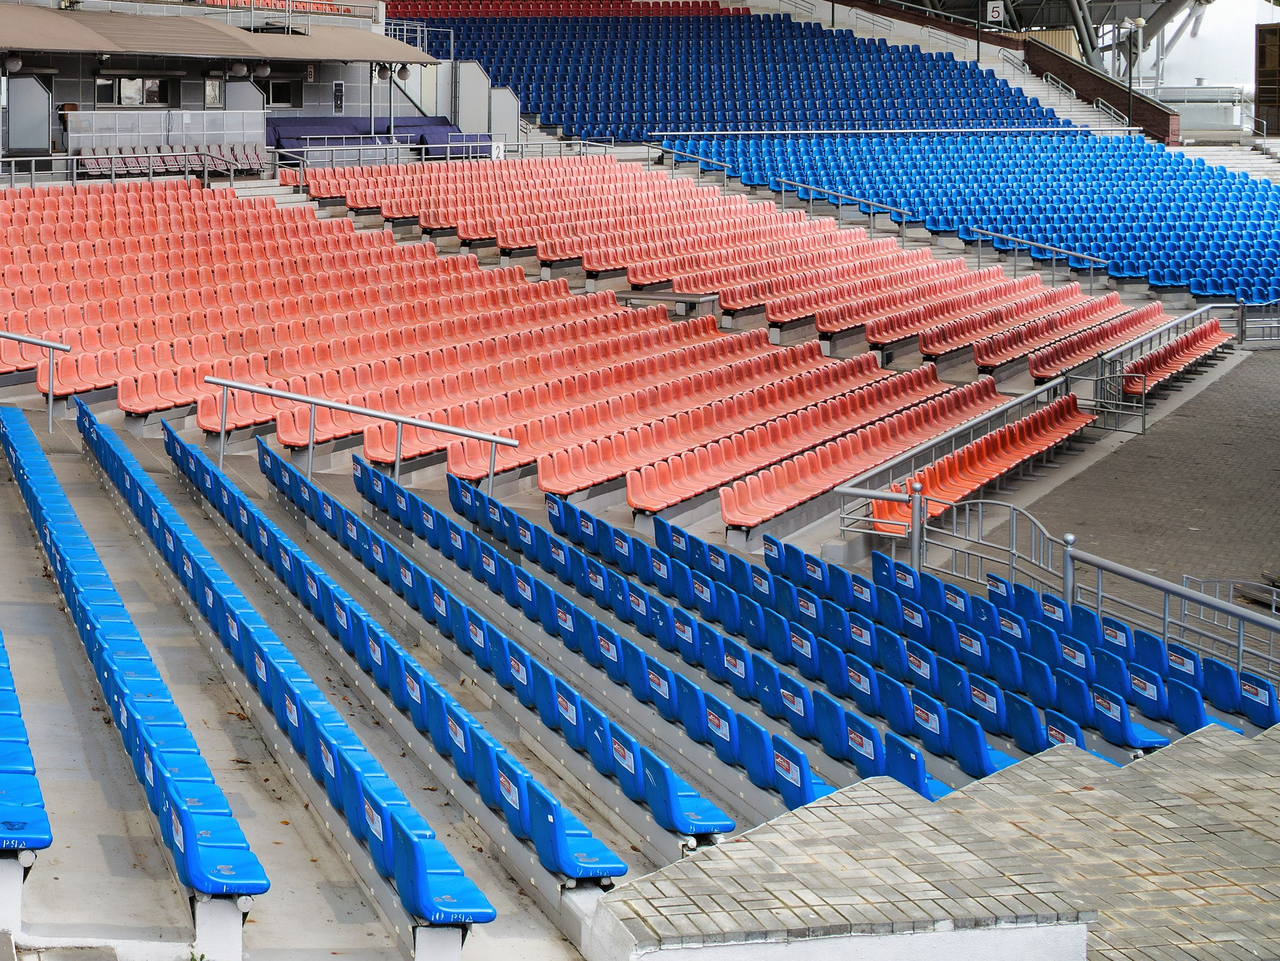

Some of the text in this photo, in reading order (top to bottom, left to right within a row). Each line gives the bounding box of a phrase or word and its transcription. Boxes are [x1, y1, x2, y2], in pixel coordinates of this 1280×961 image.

[991, 6, 1001, 19] 5
[495, 145, 501, 159] 2
[431, 911, 445, 921] 10
